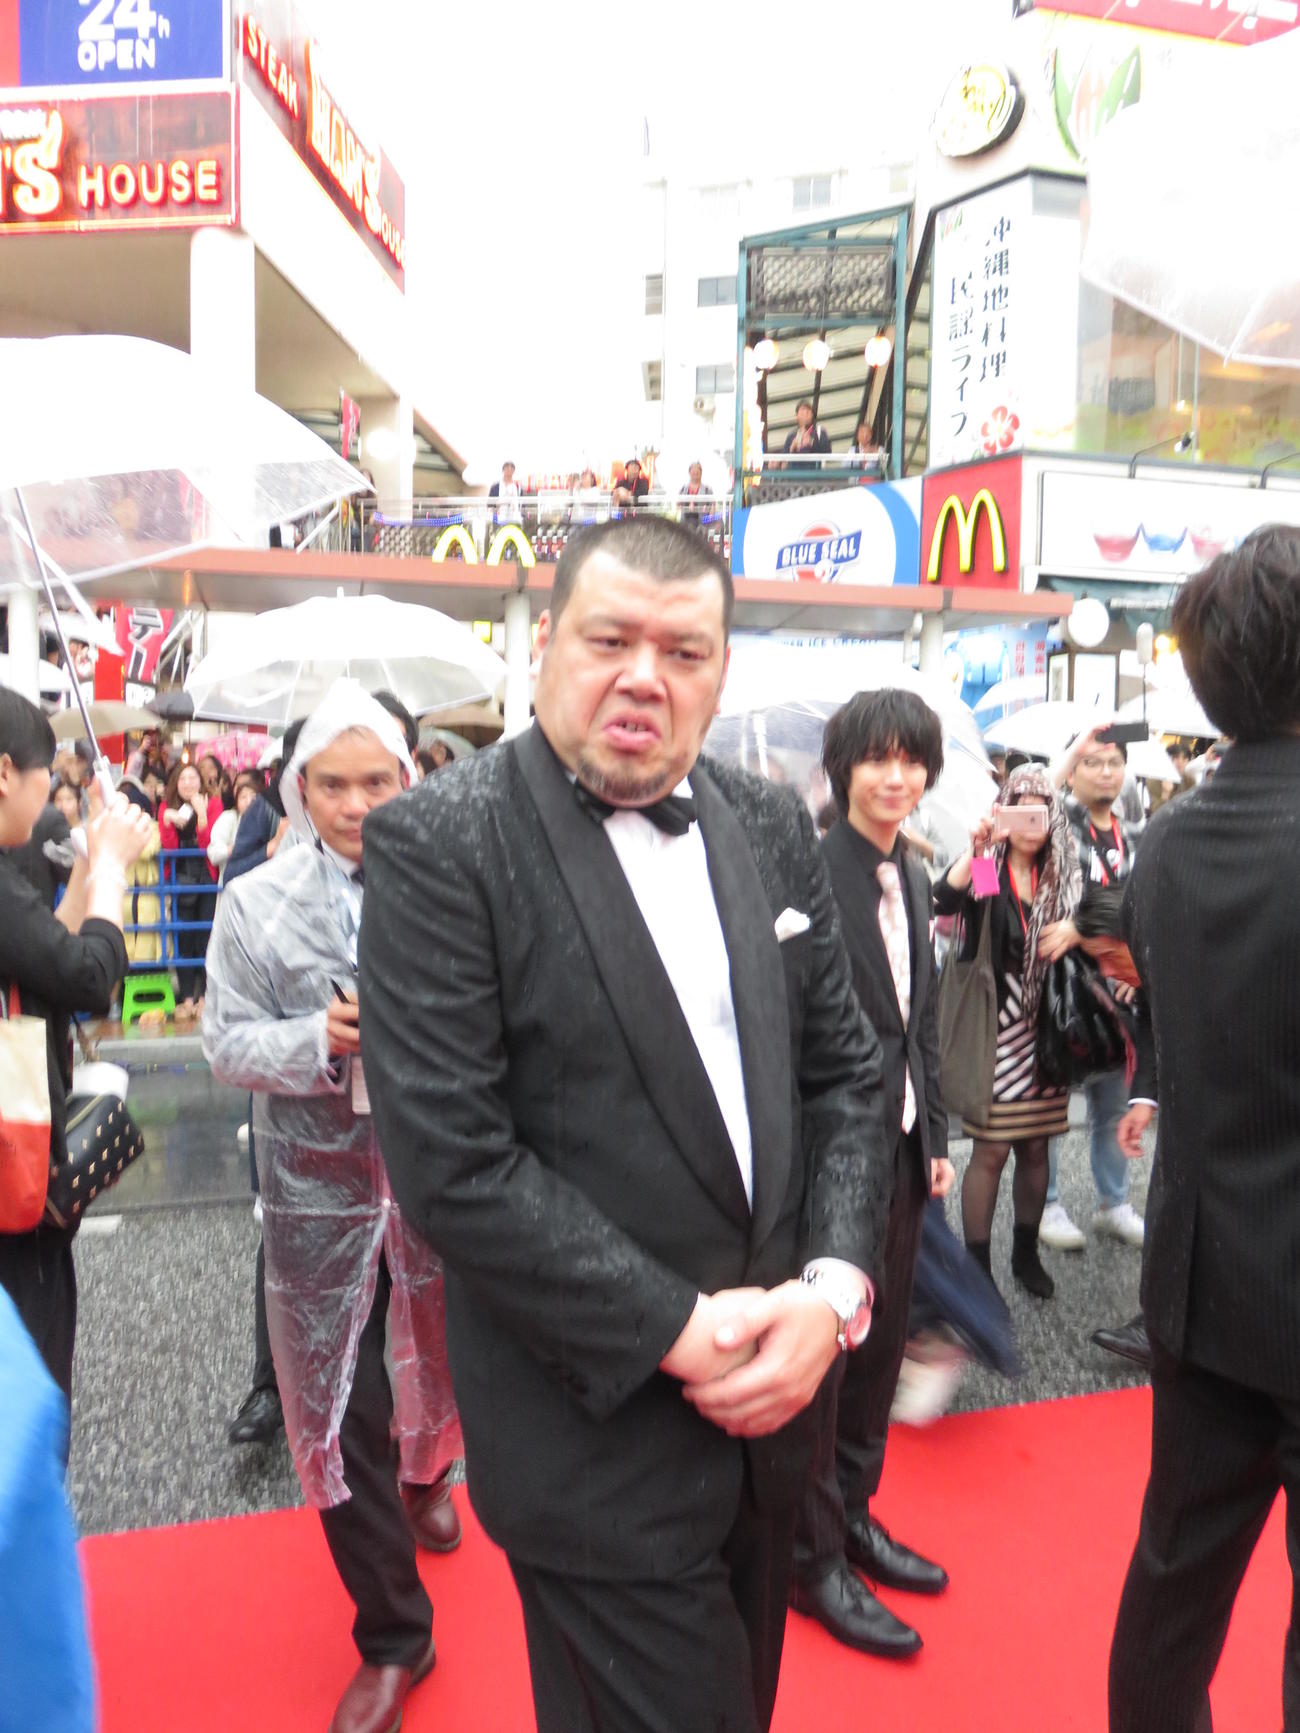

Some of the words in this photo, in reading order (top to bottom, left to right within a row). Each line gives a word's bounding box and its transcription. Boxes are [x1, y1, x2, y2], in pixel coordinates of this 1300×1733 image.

[78, 39, 156, 71] OPEN
[247, 14, 299, 118] STEAK
[79, 160, 219, 208] HOUSE
[980, 215, 1012, 383] 沖縄地料理
[781, 542, 818, 568] BLUE
[820, 536, 857, 562] SEAL
